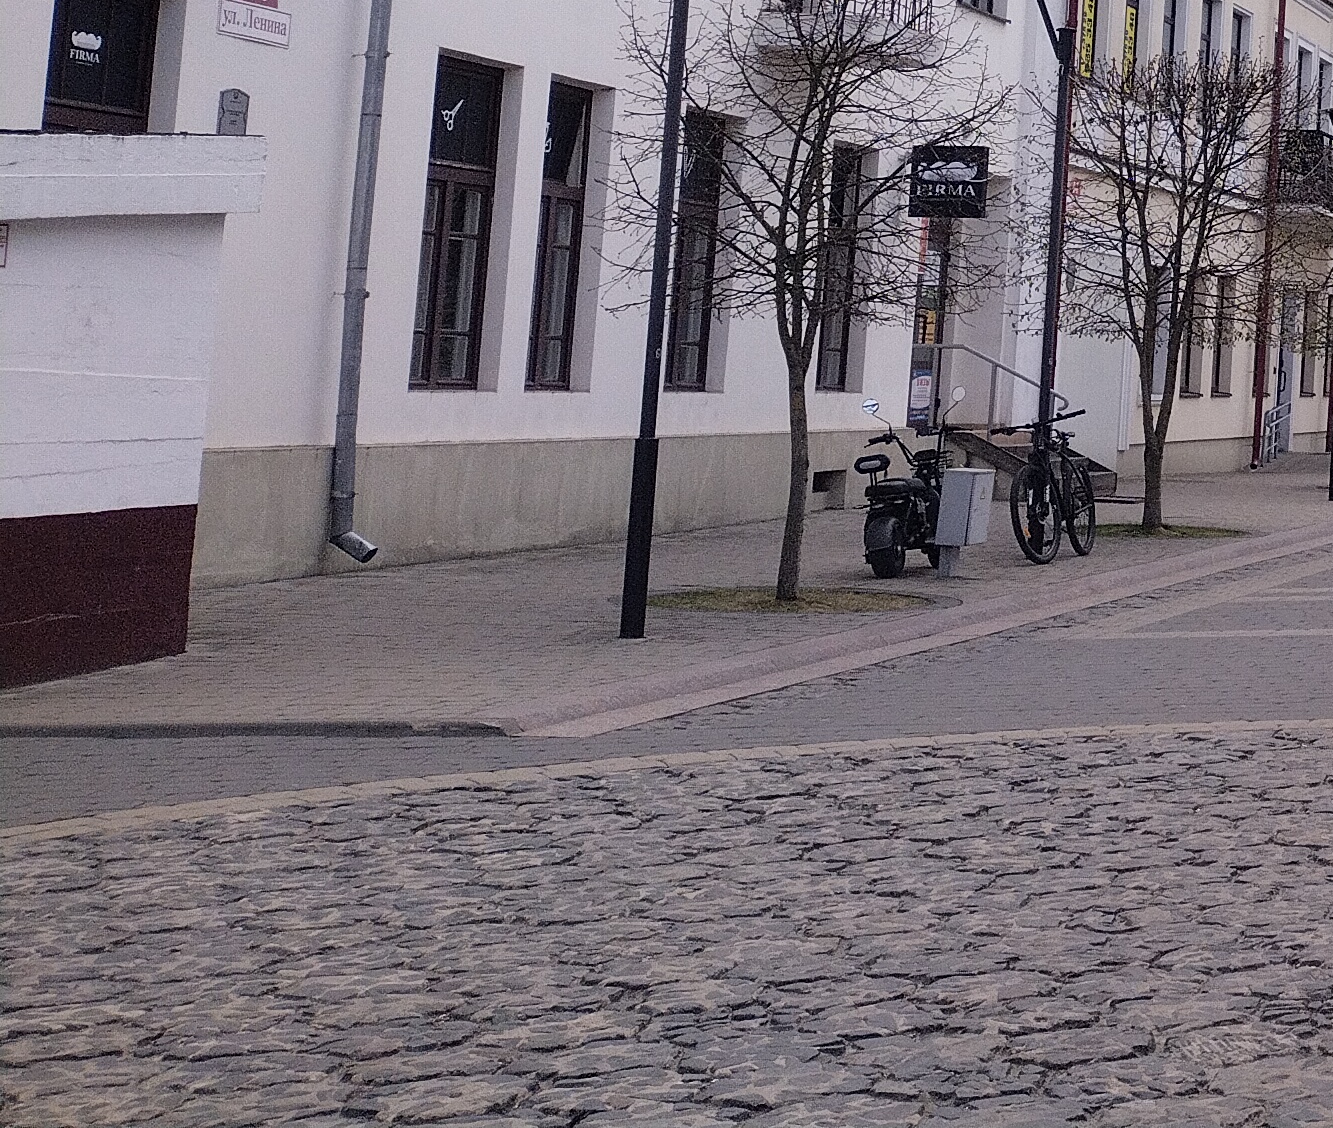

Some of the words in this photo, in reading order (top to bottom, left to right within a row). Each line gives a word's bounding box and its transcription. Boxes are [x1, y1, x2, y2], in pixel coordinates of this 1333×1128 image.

[222, 9, 240, 27] ул.
[243, 7, 287, 37] Ленина
[70, 48, 100, 63] FIRMA
[916, 183, 976, 197] FIRMA
